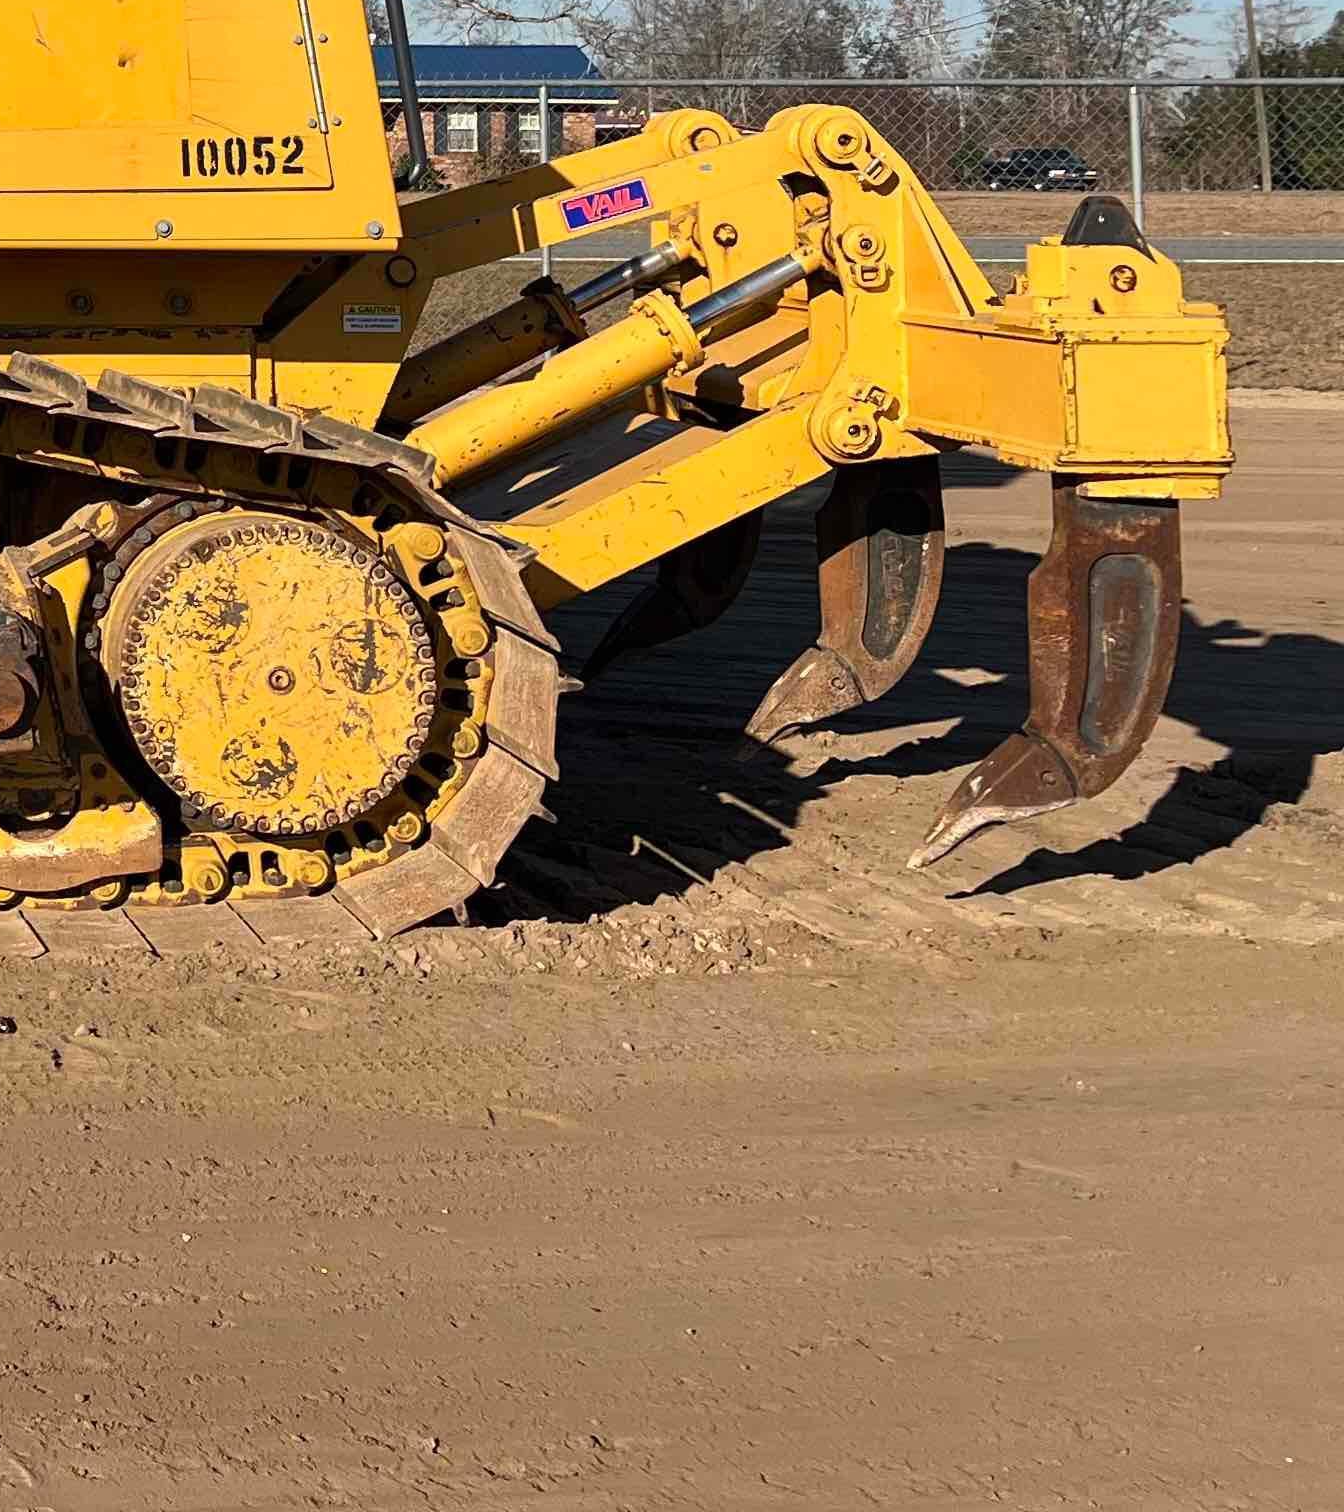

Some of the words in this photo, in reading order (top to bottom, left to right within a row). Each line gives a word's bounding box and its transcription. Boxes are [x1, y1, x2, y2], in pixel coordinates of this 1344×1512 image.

[181, 135, 304, 177] 10052
[566, 187, 644, 221] VAIL
[358, 305, 397, 314] CAUTION
